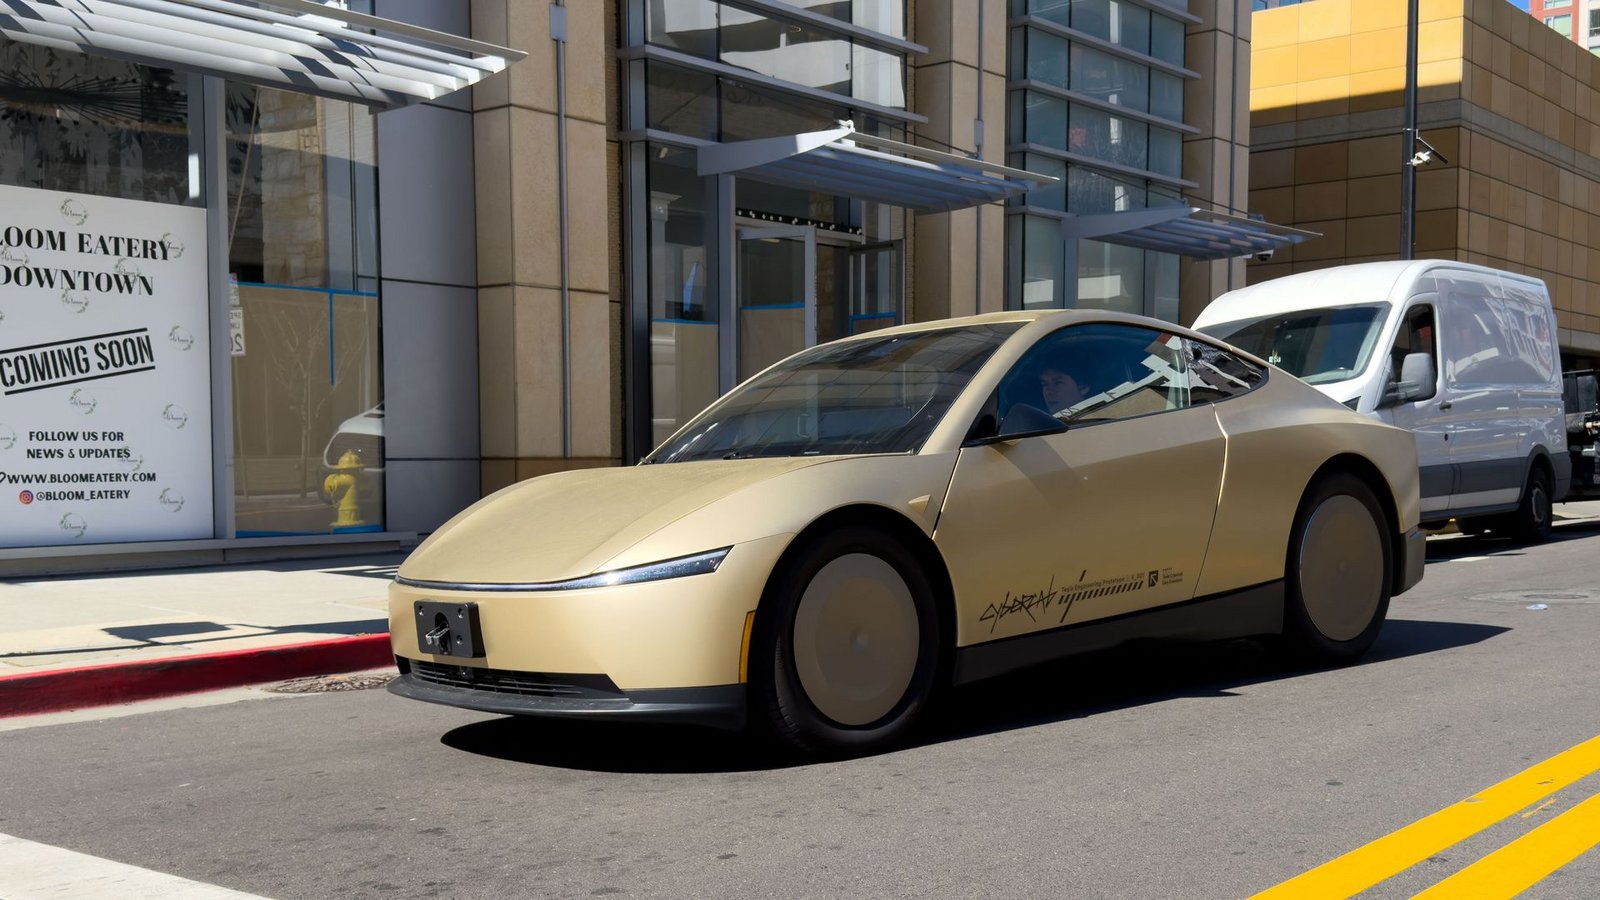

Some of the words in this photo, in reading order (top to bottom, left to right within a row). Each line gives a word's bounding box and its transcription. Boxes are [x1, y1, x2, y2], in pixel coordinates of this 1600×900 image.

[78, 233, 170, 261] EATERY
[0, 265, 153, 296] DOWNTOWN
[0, 345, 90, 387] COMING
[94, 335, 155, 371] SOON
[29, 431, 79, 441] FOLLOW
[82, 431, 98, 441] US
[102, 431, 124, 441] FOR
[27, 448, 64, 459] NEWS
[68, 448, 75, 458] &
[79, 448, 131, 458] UPDATES
[7, 473, 157, 484] WWW.BLOOMEATERY.COM
[36, 490, 131, 501] @BLOOM_EATERY
